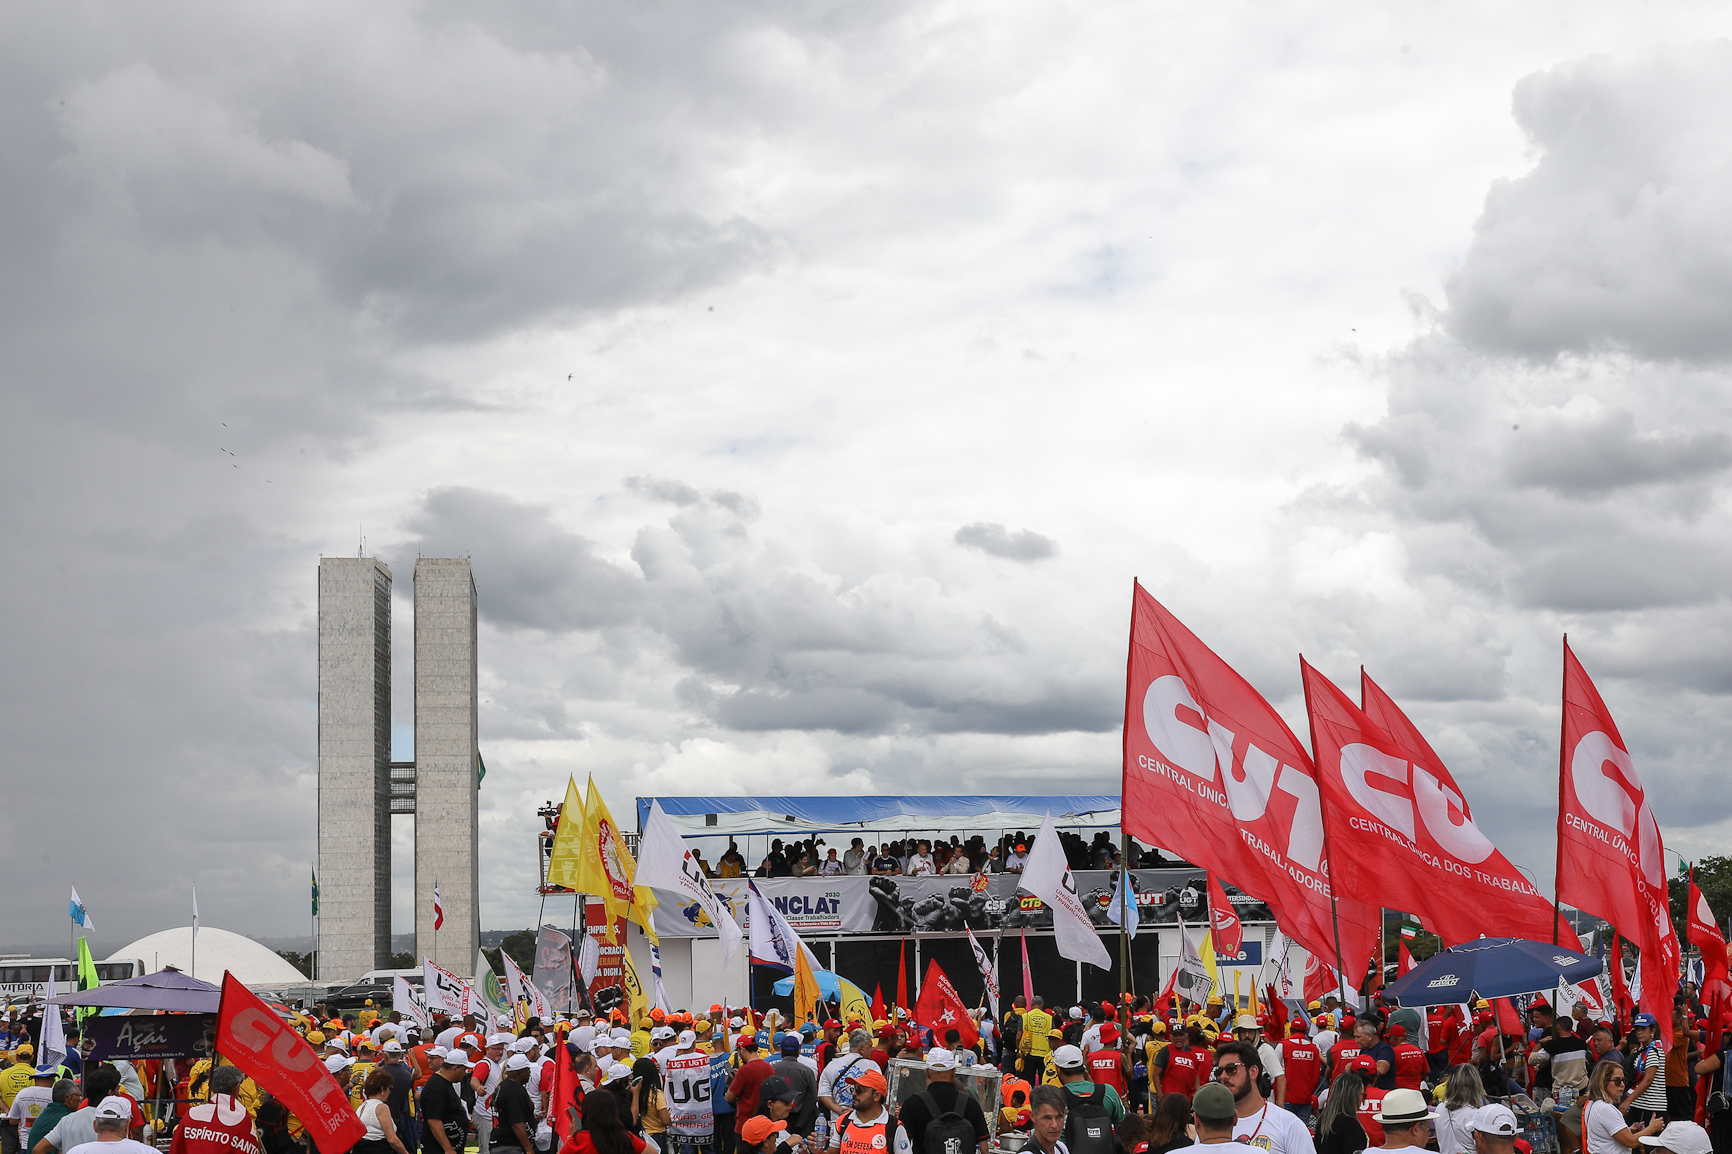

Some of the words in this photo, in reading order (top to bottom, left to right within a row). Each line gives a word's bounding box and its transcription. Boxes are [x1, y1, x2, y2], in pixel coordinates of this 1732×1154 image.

[1138, 754, 1195, 793] CENTRAL
[1143, 674, 1325, 872] CUT
[1340, 743, 1495, 865] CU
[1565, 812, 1610, 844] CENTRAL
[1349, 816, 1407, 848] CENTRAL
[1444, 860, 1472, 879] DOS
[1474, 869, 1543, 898] TRABALH
[1240, 828, 1339, 902] TRABALADORE
[1055, 889, 1074, 905] UNIÃO
[985, 900, 1007, 910] CSB
[1020, 898, 1042, 908] CTB
[587, 925, 621, 934] EMPRES,
[1, 982, 44, 992] VITÓRIA
[1427, 977, 1460, 988] HAVAN
[219, 1036, 246, 1056] ENTRAL
[1291, 1049, 1312, 1059] CUT
[1341, 1049, 1361, 1057] CUT
[1093, 1059, 1113, 1067] CUT
[1174, 1056, 1193, 1066] CUT
[668, 1078, 711, 1104] UG
[1359, 1099, 1381, 1111] UT
[184, 1126, 230, 1145] ESPÍRITO
[676, 1135, 693, 1143] UGT
[854, 1142, 873, 1151] DEFESA
